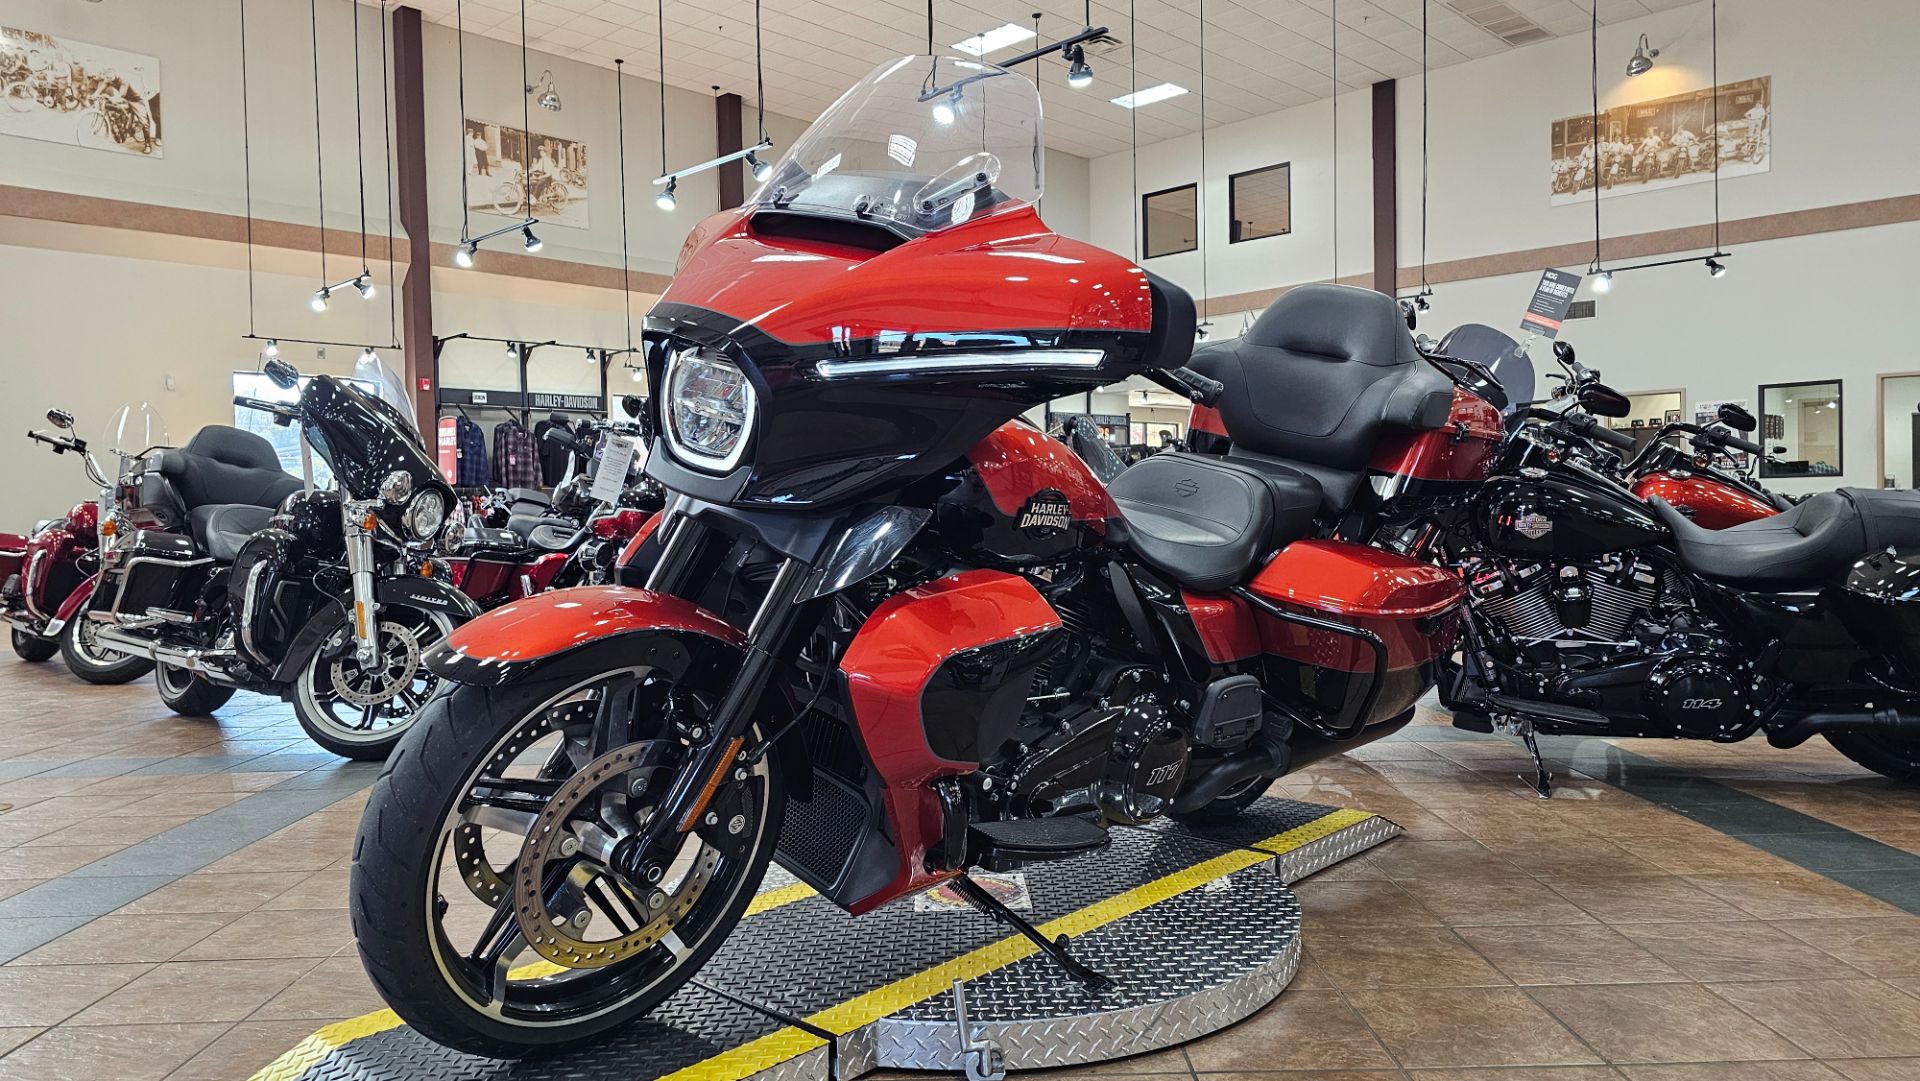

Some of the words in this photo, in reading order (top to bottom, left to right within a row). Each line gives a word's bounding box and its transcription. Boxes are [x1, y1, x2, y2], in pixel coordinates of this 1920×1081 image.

[535, 394, 598, 409] HARLEY-DAVIDSON
[1020, 513, 1070, 530] DAVIDSON
[1682, 698, 1722, 709] 114
[1146, 758, 1184, 786] 117
